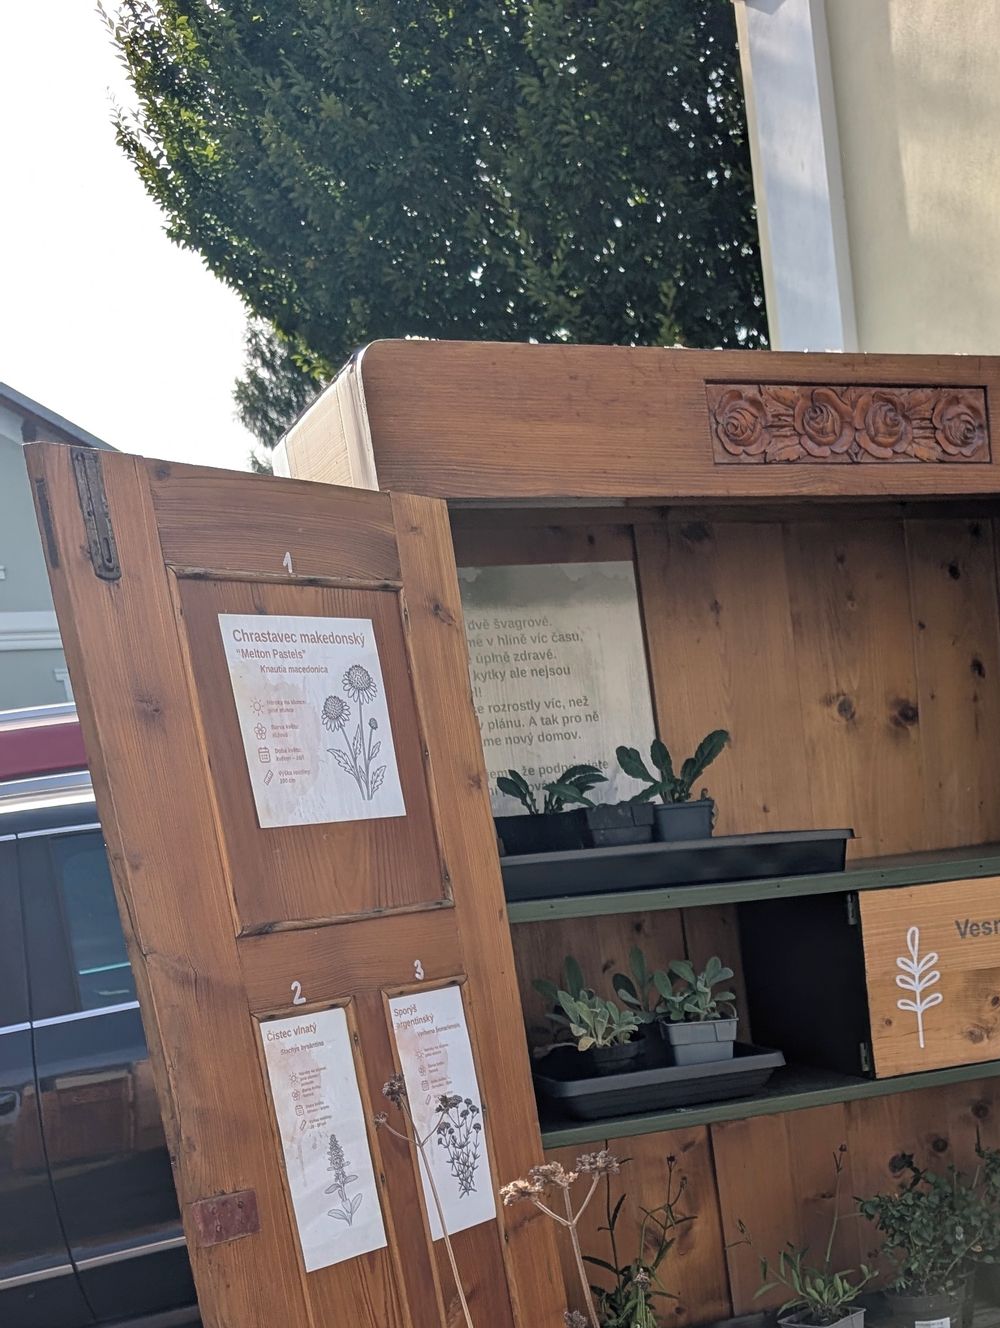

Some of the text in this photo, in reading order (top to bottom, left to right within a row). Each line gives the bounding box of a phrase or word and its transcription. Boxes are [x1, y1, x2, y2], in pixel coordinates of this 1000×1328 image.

[282, 551, 294, 576] 1
[494, 616, 552, 631] švagrové.
[232, 628, 365, 648] Chrastavec makedonský
[497, 633, 527, 647] hlíně
[530, 632, 548, 645] víc
[476, 648, 557, 666] úplně zdravé.
[473, 664, 571, 683] kytky ale nejsou
[488, 698, 541, 715] rozrostly
[543, 698, 566, 710] víc,
[569, 695, 589, 708] než
[488, 717, 525, 733] plánu.
[529, 715, 538, 727] A
[540, 714, 559, 726] tak
[562, 713, 582, 727] pro
[585, 711, 600, 722] ně
[505, 733, 534, 747] nový
[537, 730, 582, 743] domov.
[522, 764, 535, 777] že
[290, 980, 307, 1005] 2
[266, 1022, 318, 1043] Čistec vlnatý
